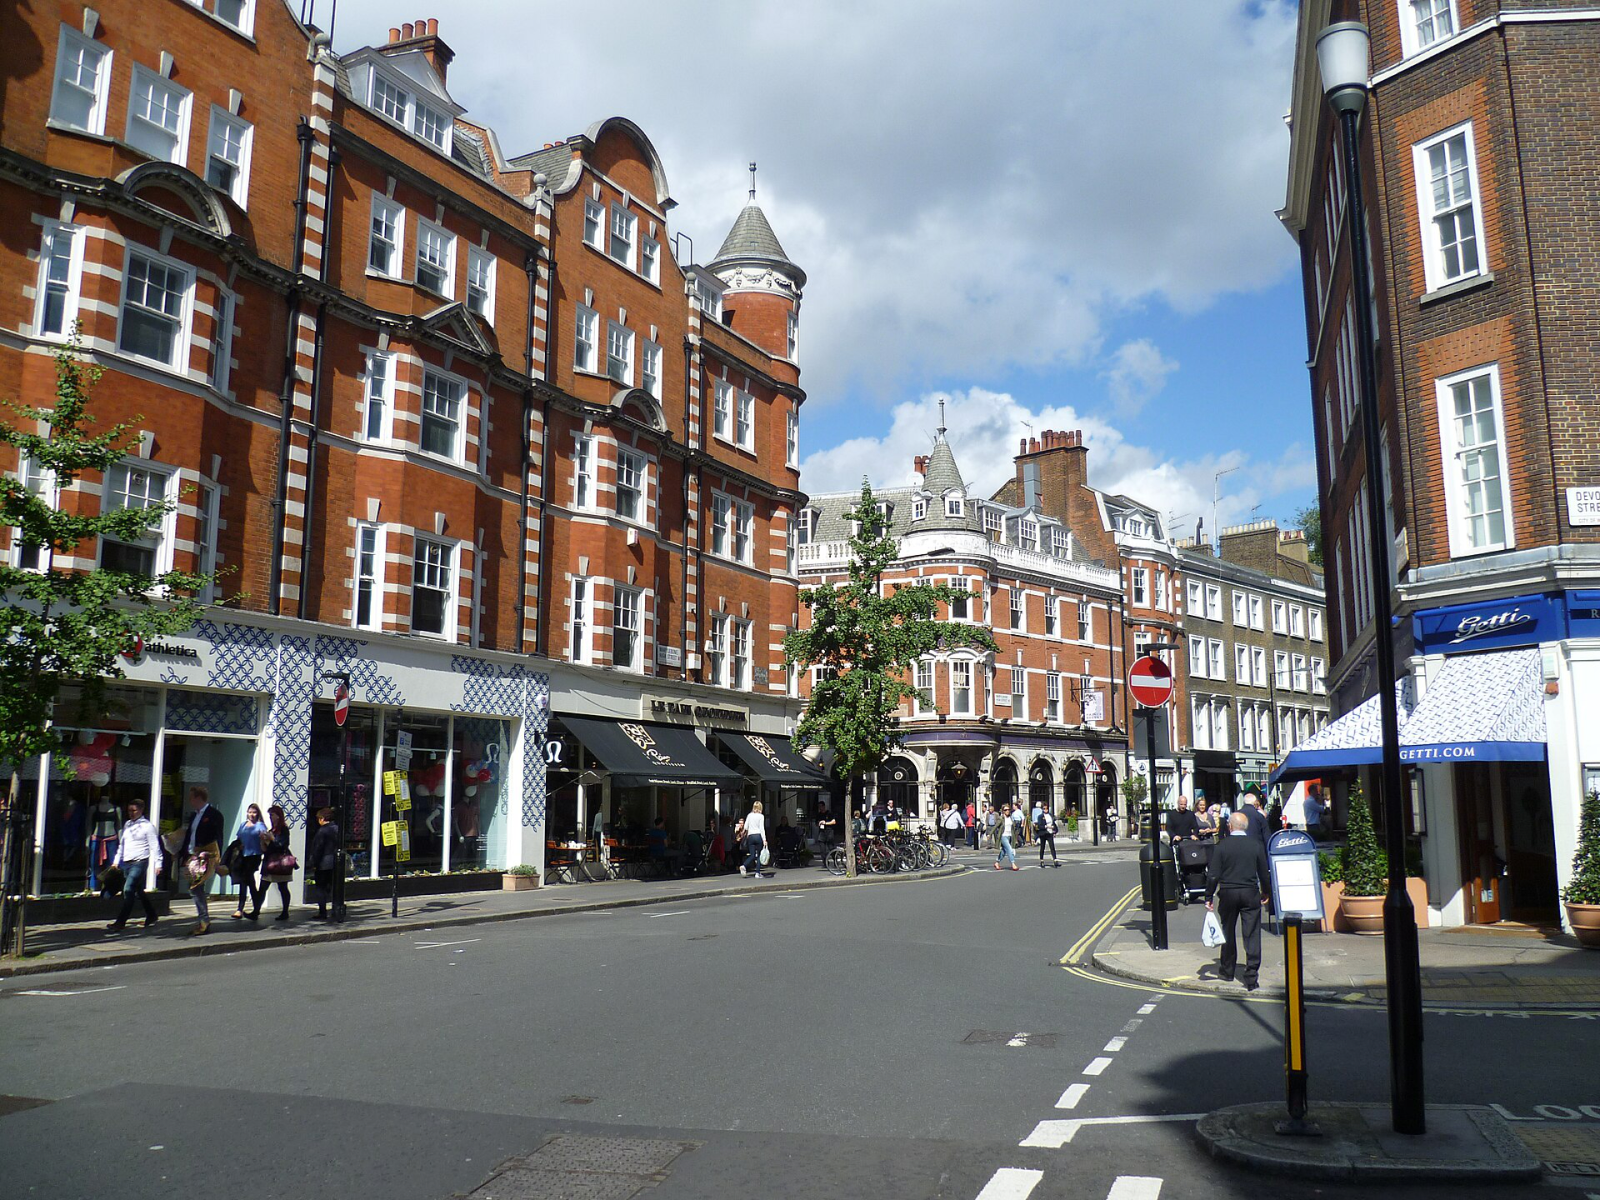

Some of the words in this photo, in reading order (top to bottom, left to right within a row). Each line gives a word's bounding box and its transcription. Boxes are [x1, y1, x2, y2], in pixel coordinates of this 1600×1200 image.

[1449, 607, 1531, 644] Getti
[144, 642, 197, 657] athletica
[1399, 747, 1475, 760] GETTI.COM
[1276, 836, 1308, 849] Getti
